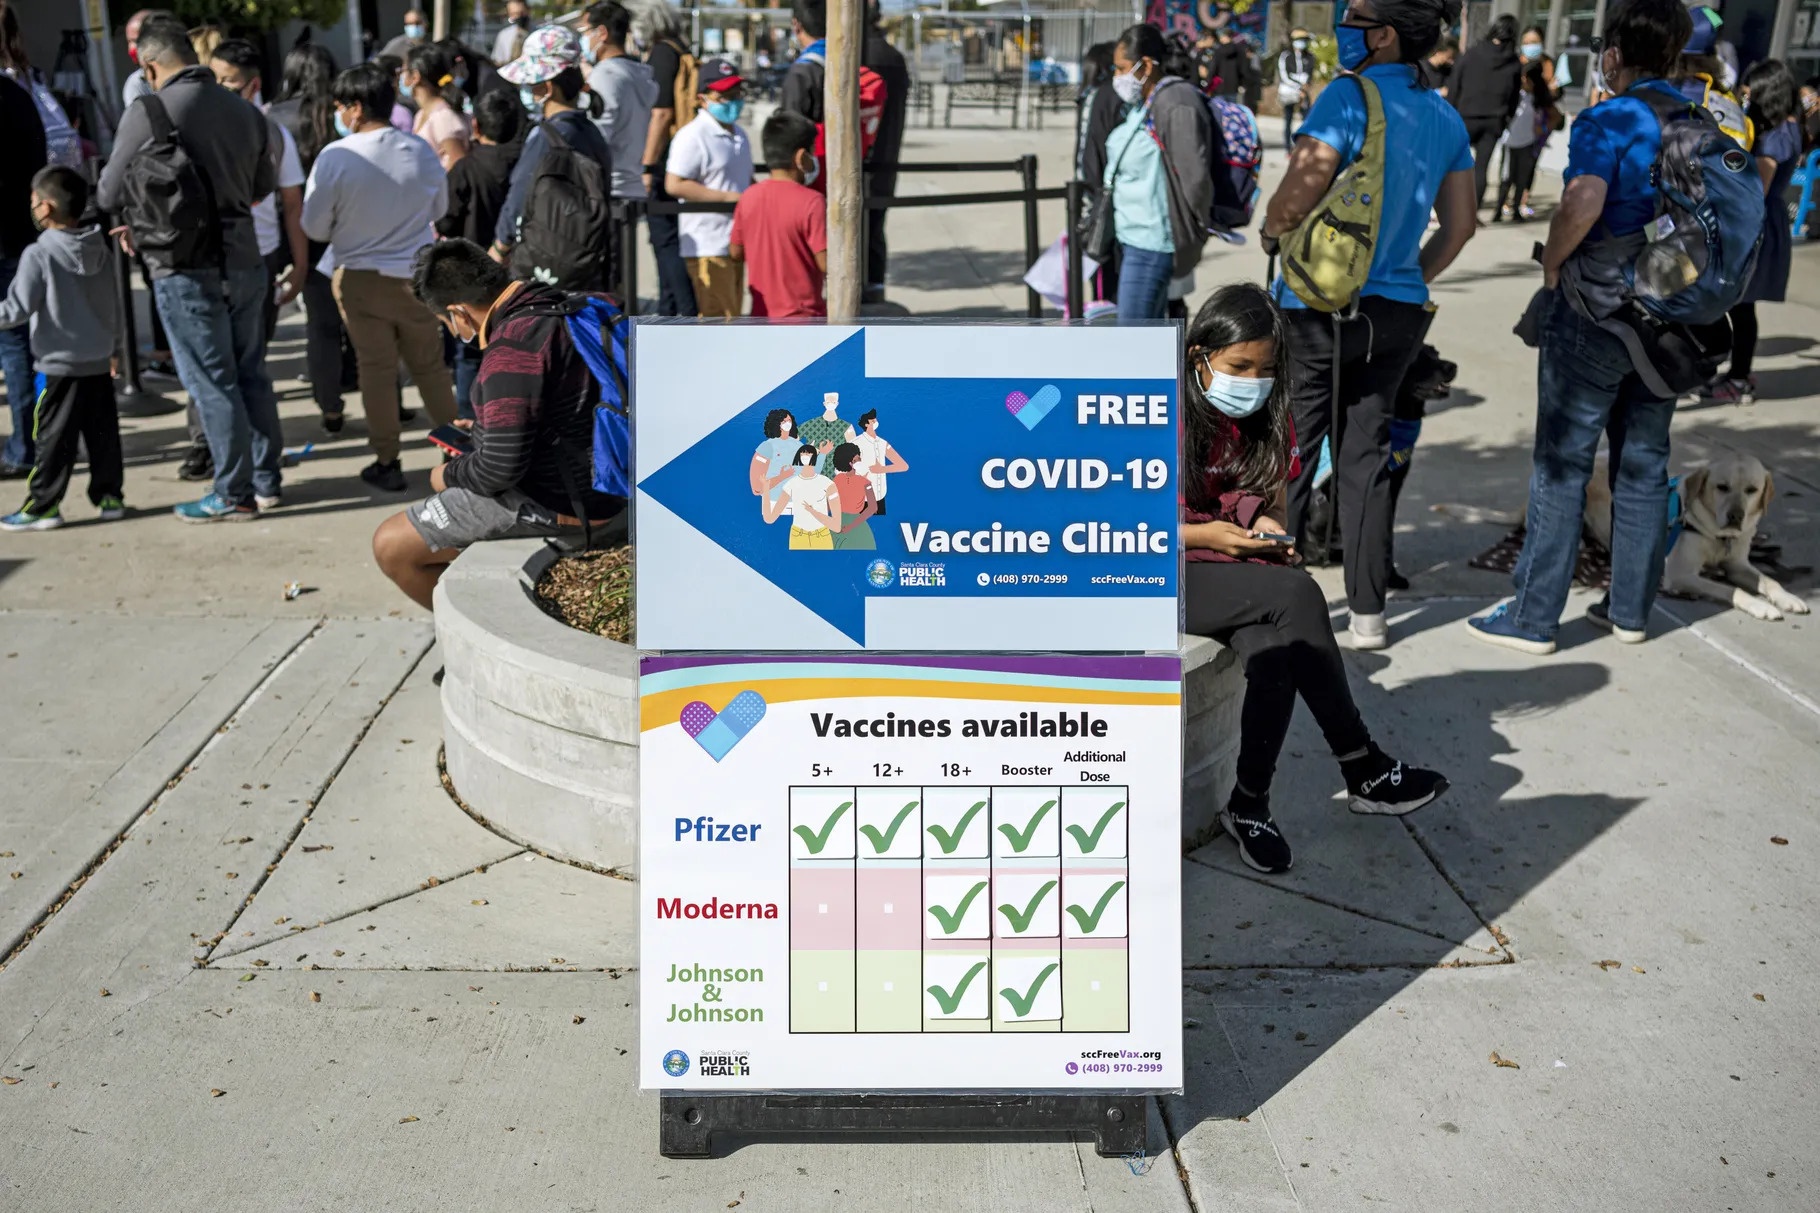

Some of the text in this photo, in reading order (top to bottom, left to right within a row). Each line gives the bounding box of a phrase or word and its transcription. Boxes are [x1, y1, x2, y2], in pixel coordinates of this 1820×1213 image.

[1077, 394, 1169, 425] FREE
[981, 458, 1168, 490] COVID-19
[900, 521, 1168, 554] Vaccine Clinic
[899, 567, 945, 577] PUBLIC
[900, 576, 946, 586] HEALTH
[993, 574, 1068, 586] (408) 970-2999
[1091, 574, 1166, 586] sccFreeVax.org
[810, 711, 1108, 738] Vaccines available
[1063, 750, 1126, 763] Additional
[812, 763, 833, 778] 5+
[872, 763, 904, 777] 12+
[940, 762, 972, 777] 18+
[1001, 764, 1054, 776] Booster
[1080, 770, 1111, 782] Dose
[675, 815, 762, 842] Pfizer
[657, 896, 778, 920] Moderna
[666, 962, 764, 983] Johnson
[701, 983, 723, 1003] &
[666, 1002, 764, 1023] Johnson
[699, 1055, 748, 1066] PUBLIC
[1081, 1050, 1162, 1061] sccFreeVax.org
[700, 1065, 750, 1076] HEALTH
[1082, 1063, 1163, 1074] (408) 970-2999
